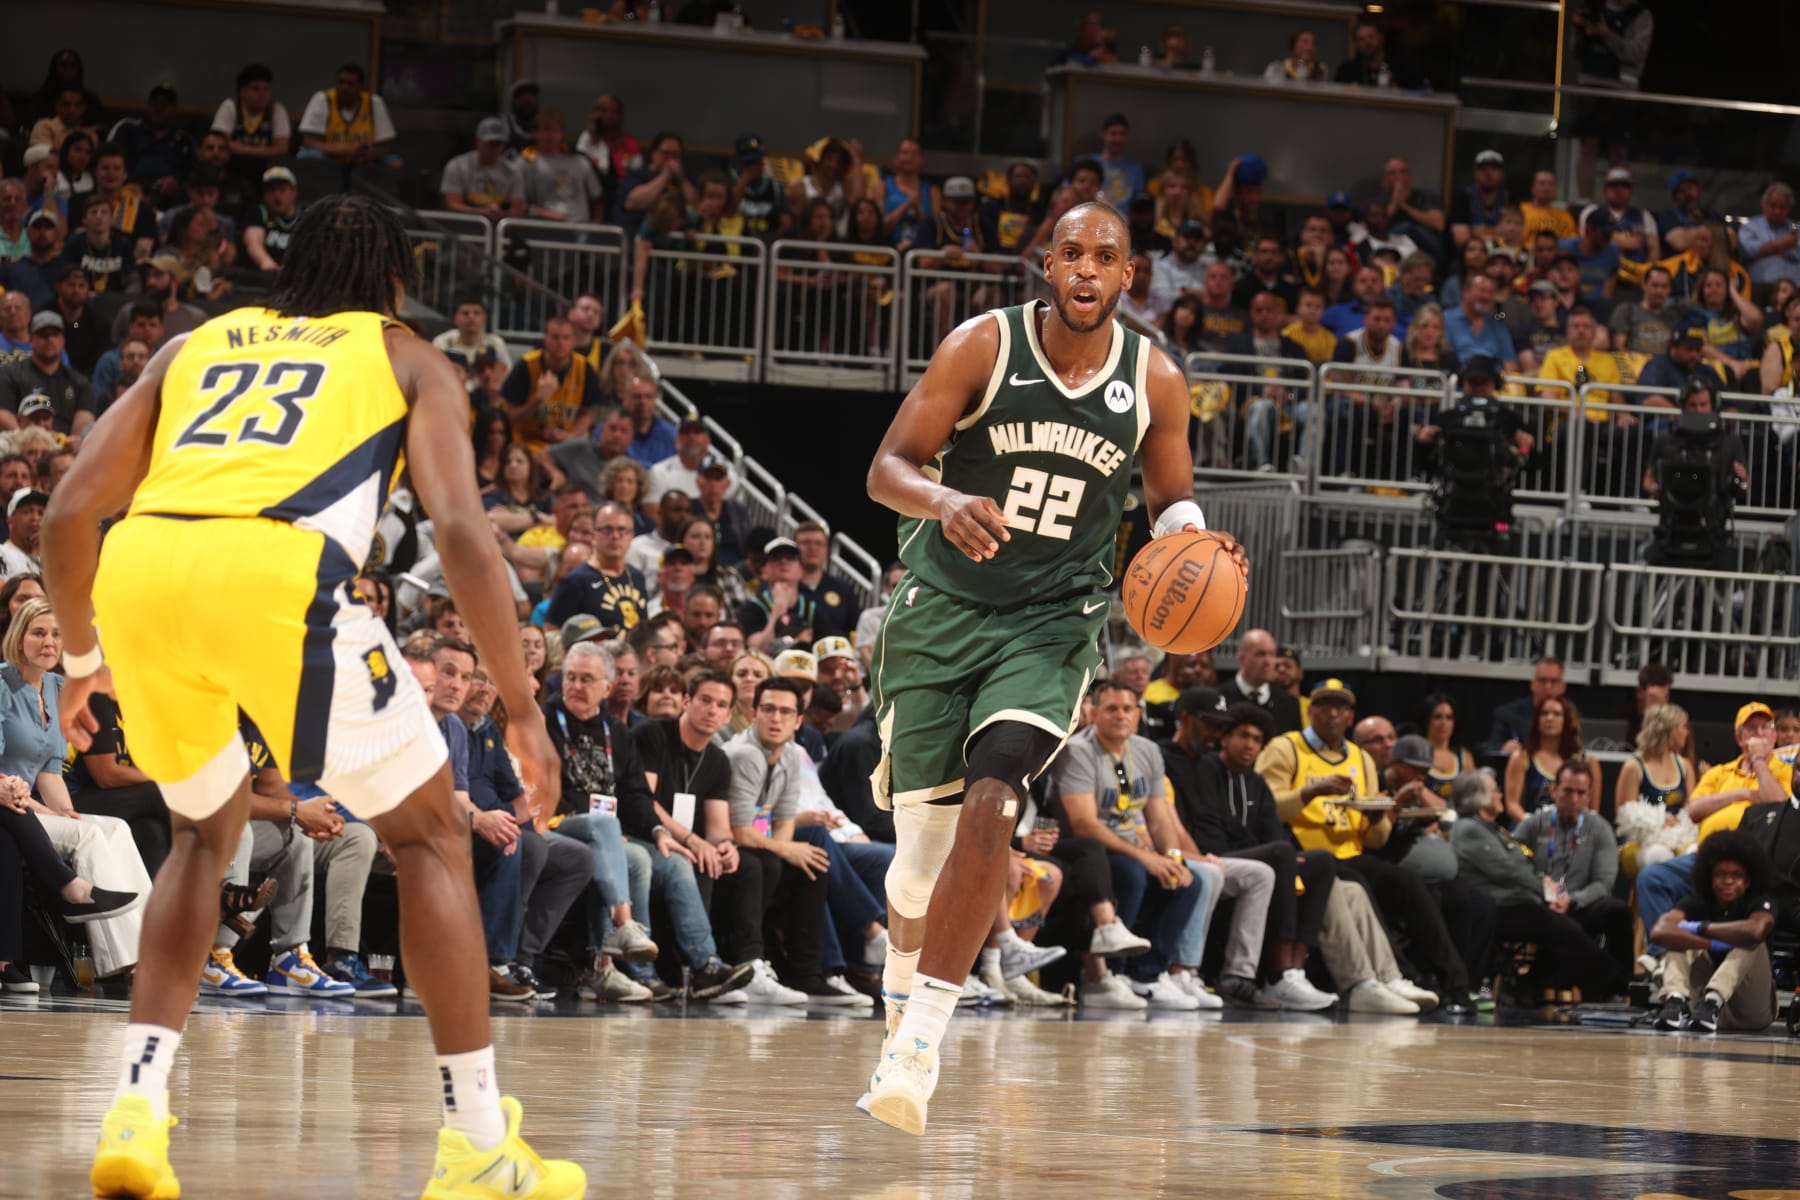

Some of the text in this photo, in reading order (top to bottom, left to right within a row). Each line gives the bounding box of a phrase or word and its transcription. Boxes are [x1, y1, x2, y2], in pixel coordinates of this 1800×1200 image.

[226, 324, 350, 349] NESMITH
[173, 360, 327, 450] 23
[988, 421, 1127, 478] MILWAUKEE
[1002, 466, 1087, 541] 22
[1149, 559, 1204, 631] Wilson
